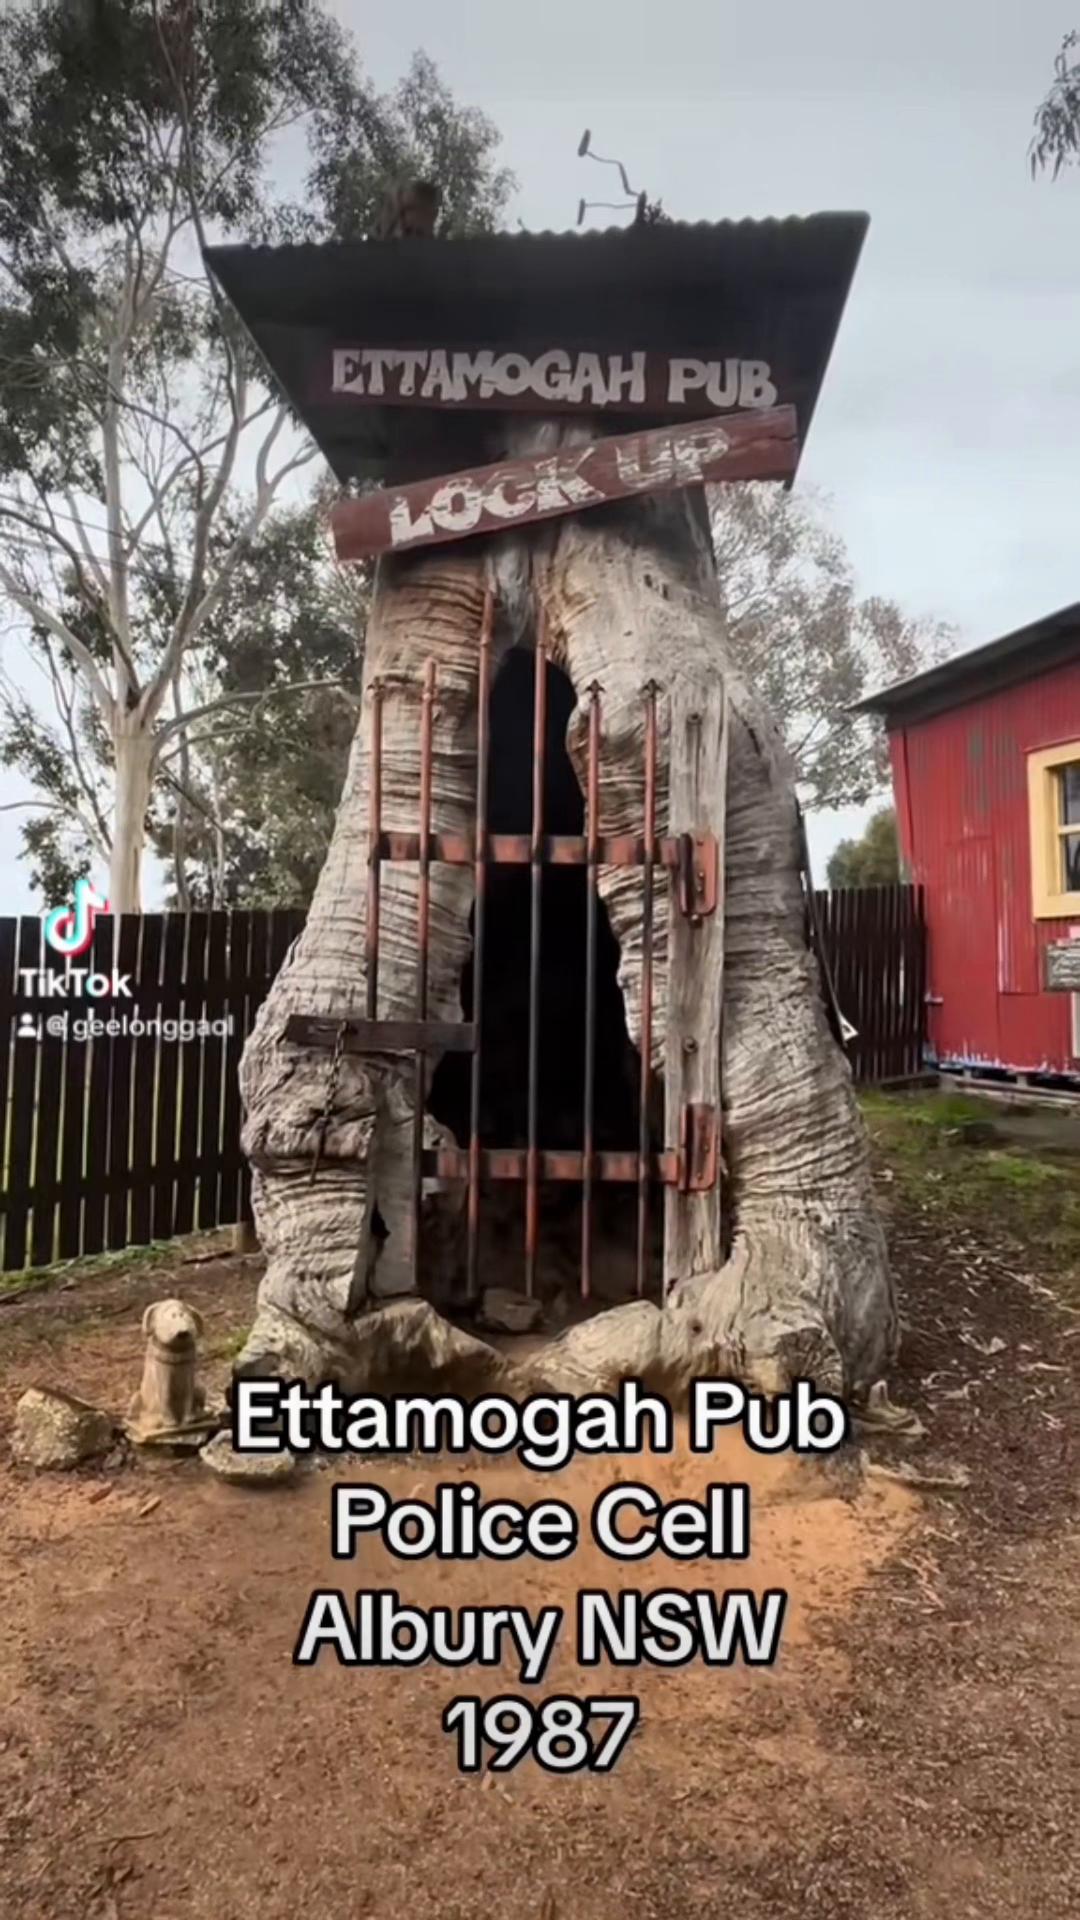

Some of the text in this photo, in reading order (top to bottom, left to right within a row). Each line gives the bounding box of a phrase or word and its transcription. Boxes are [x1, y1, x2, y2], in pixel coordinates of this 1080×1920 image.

[331, 348, 778, 408] ETTAMOGAH PUB
[389, 426, 730, 546] LOCK UP
